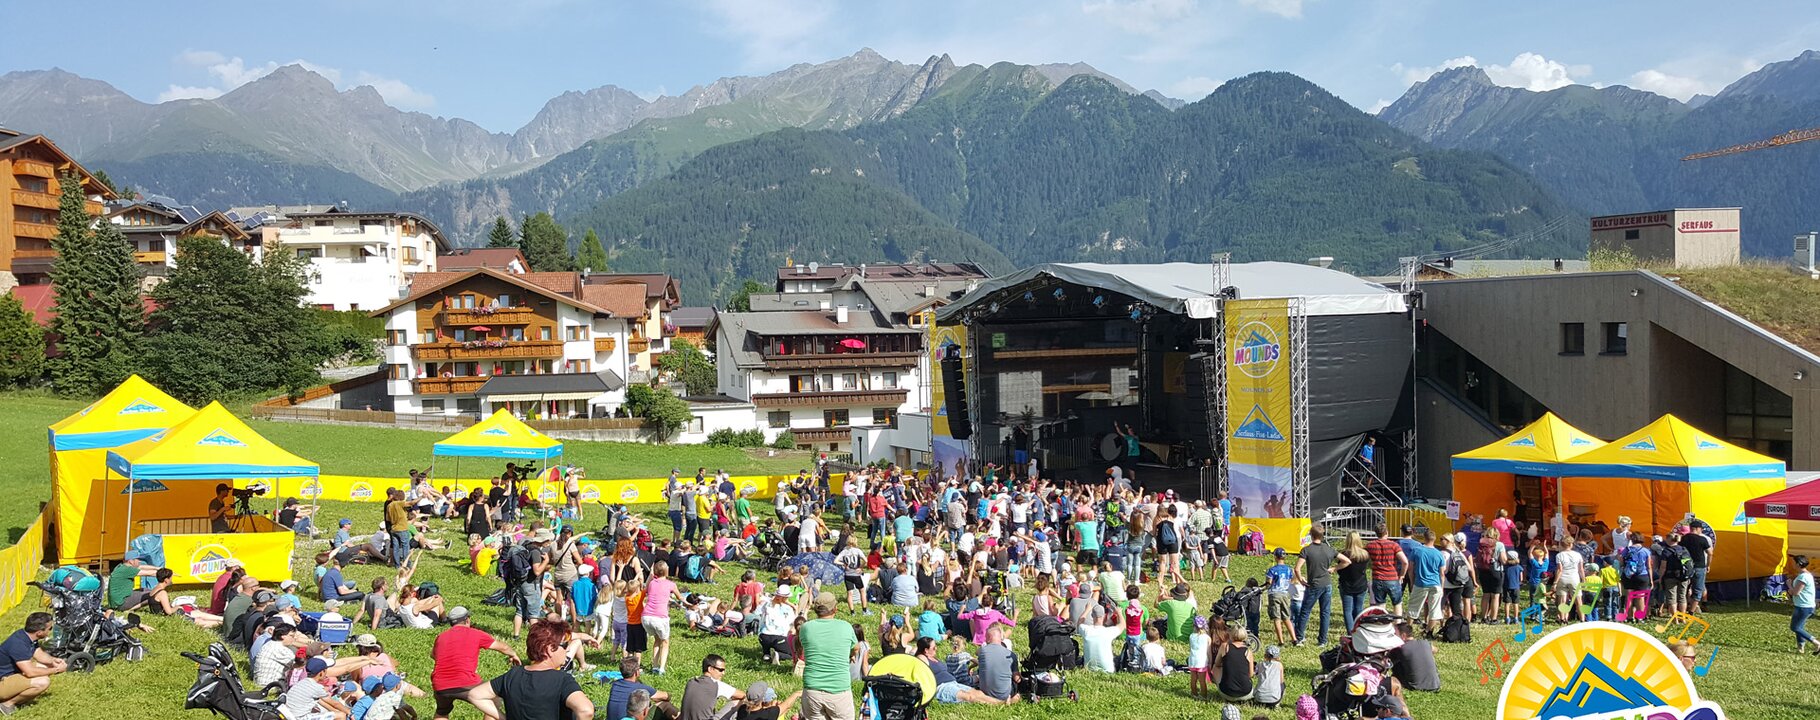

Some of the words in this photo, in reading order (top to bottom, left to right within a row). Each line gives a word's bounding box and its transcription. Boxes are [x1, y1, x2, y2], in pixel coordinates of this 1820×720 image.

[1592, 214, 1668, 228] KULTURZENTRUM
[1681, 221, 1714, 230] SERFAUS
[1234, 343, 1280, 365] MOUNDS
[1767, 505, 1786, 513] EUROPA
[192, 560, 229, 575] MOUND
